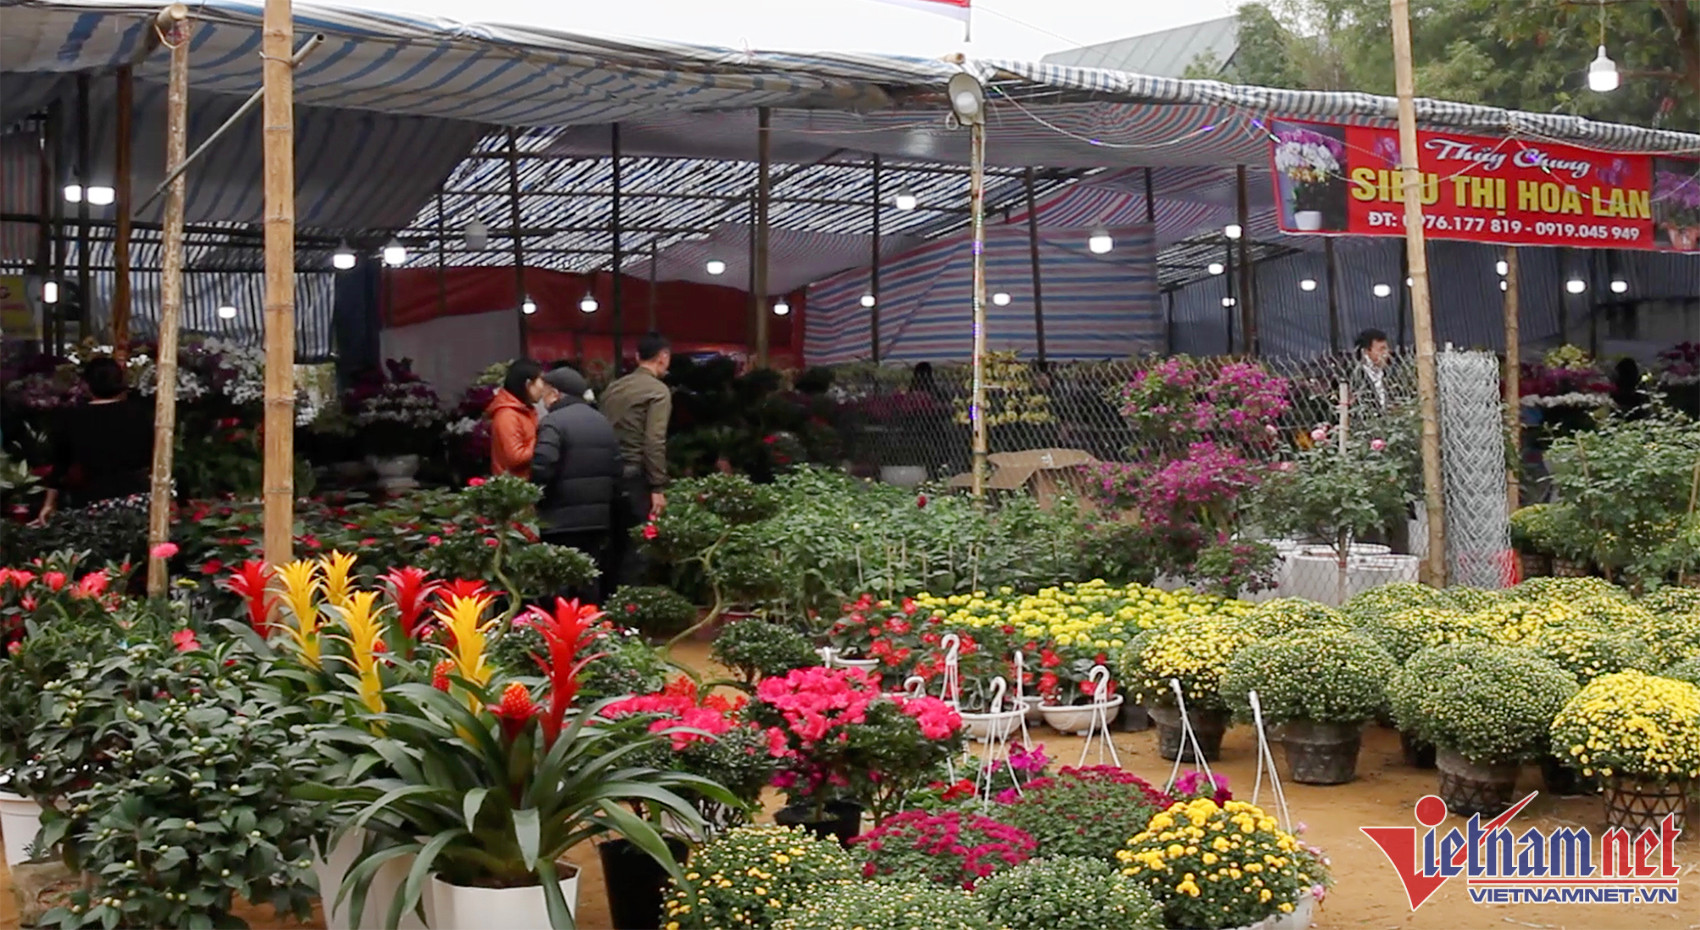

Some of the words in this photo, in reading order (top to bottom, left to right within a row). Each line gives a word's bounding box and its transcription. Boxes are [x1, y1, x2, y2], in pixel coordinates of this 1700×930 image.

[1450, 175, 1506, 216] THỊ
[1517, 180, 1583, 215] HOA
[1592, 186, 1652, 219] LAN
[1368, 211, 1397, 227] ĐT:
[1402, 213, 1485, 232] 76.177
[1490, 219, 1522, 234] 819
[1535, 222, 1608, 238] 0919.045
[1611, 226, 1640, 241] 949
